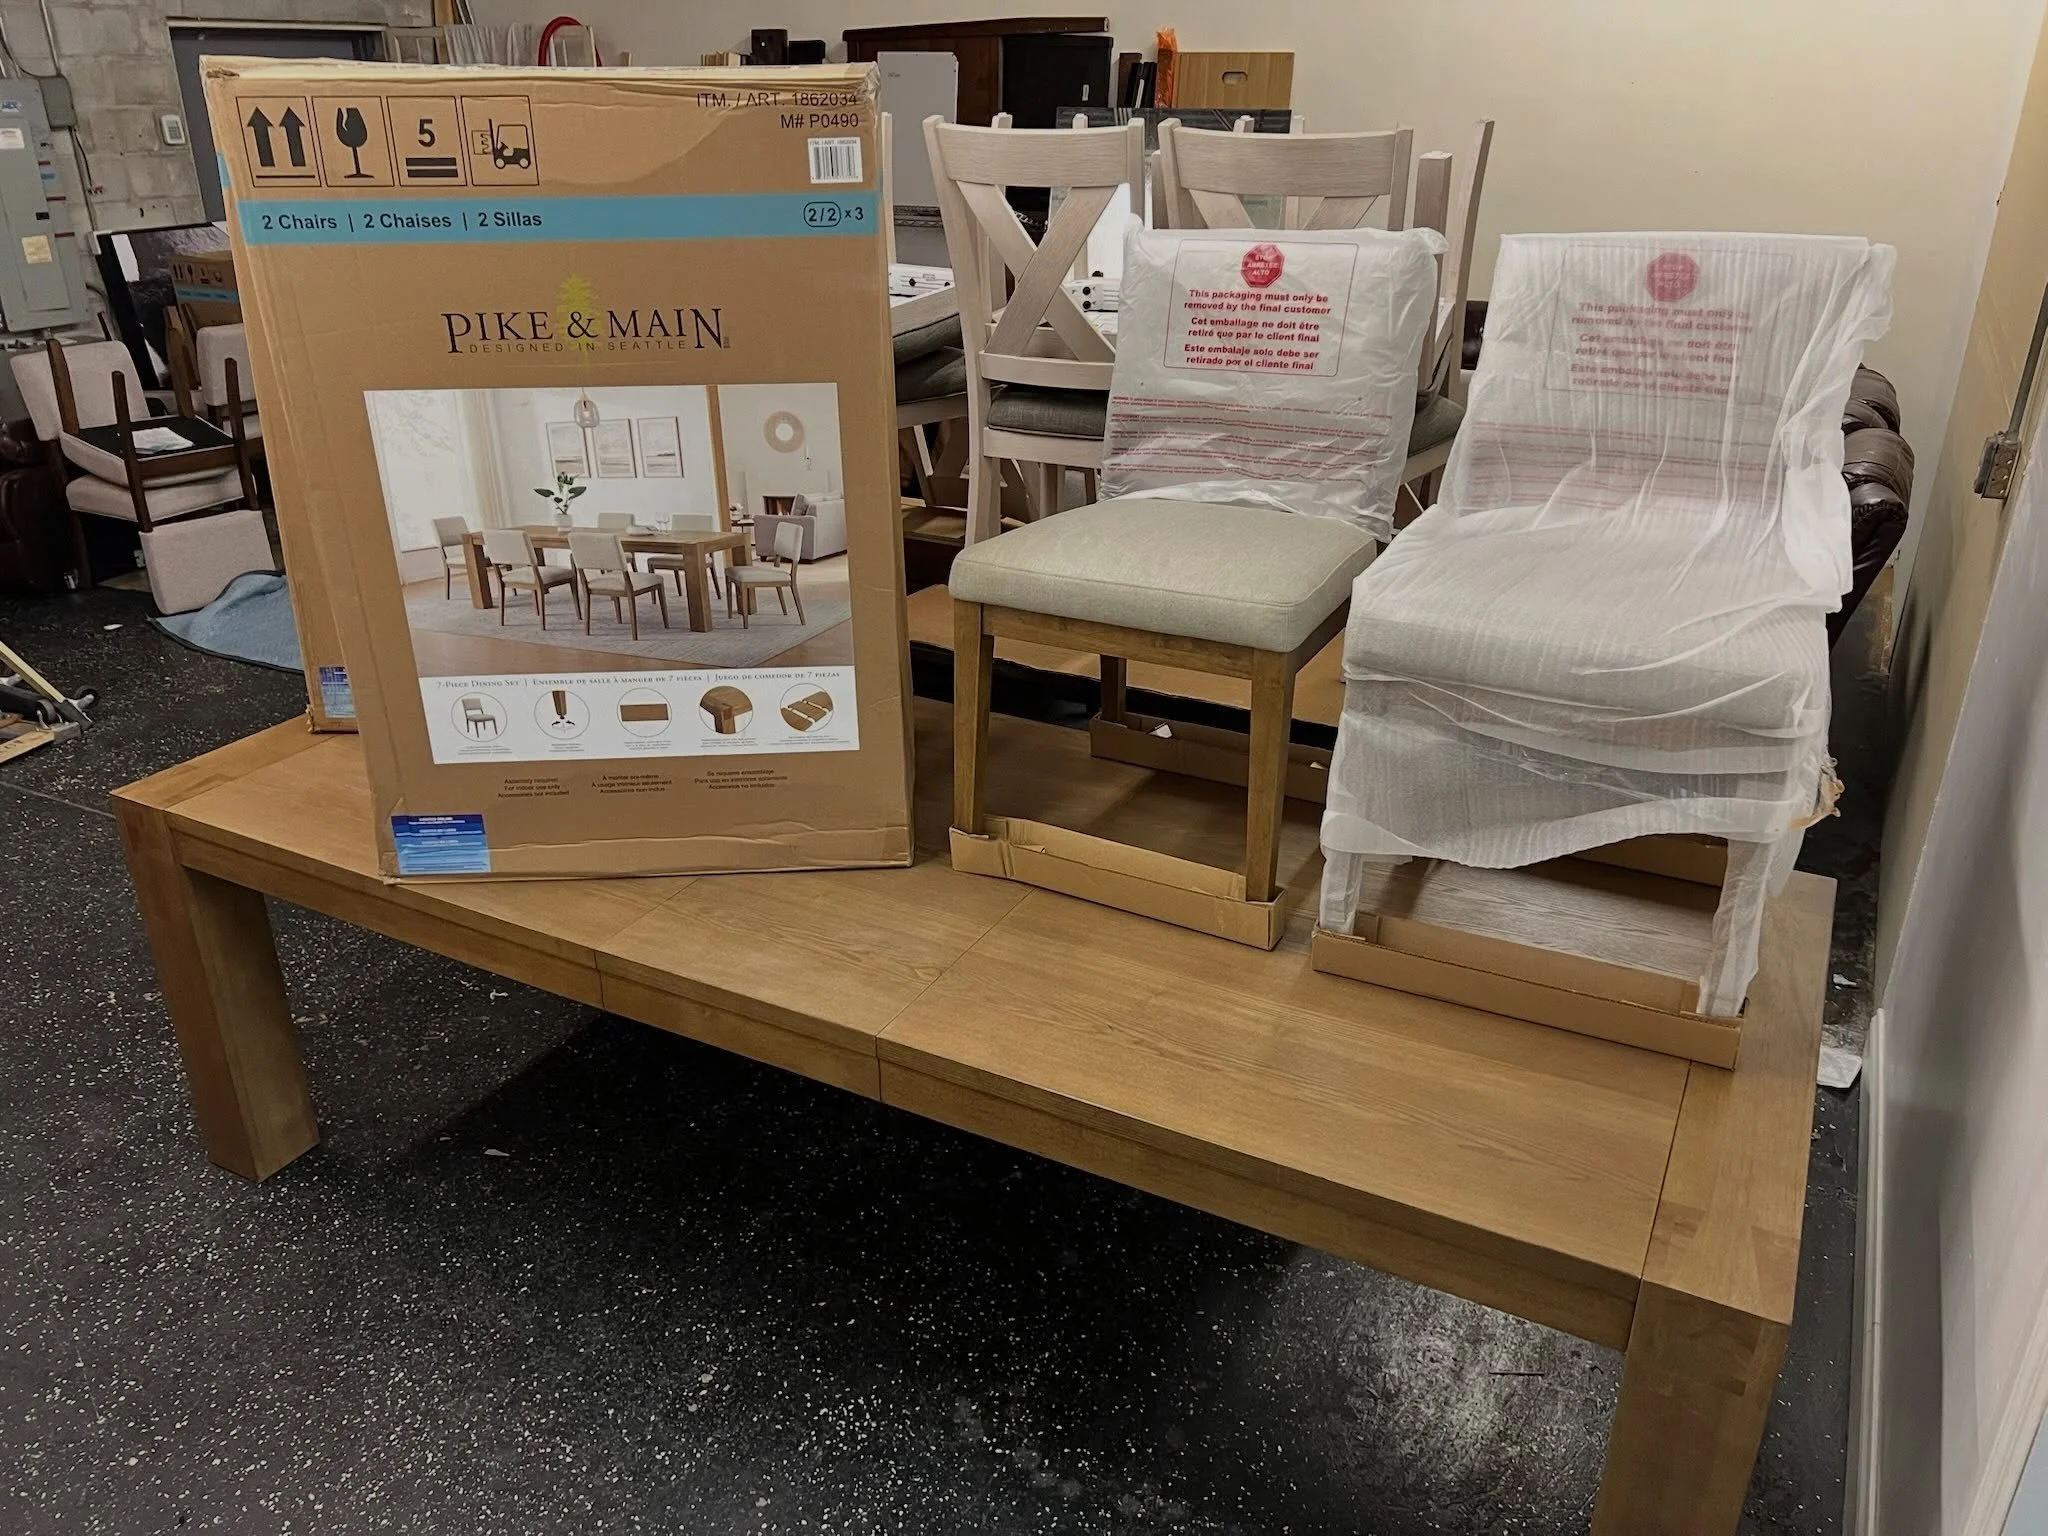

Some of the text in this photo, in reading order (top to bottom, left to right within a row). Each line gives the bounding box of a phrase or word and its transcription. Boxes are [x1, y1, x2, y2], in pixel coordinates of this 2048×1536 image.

[696, 93, 730, 107] ITM.
[747, 92, 785, 106] ART.
[793, 92, 858, 107] 1862034
[781, 113, 859, 128] M# P0490
[418, 118, 435, 147] 5
[262, 215, 273, 230] 2
[278, 214, 337, 230] Chairs
[364, 214, 376, 229] 2
[380, 213, 452, 229] Chaises
[478, 212, 489, 227] 2
[494, 211, 542, 227] Sillas
[1189, 289, 1328, 304] This packaging must only be
[1227, 302, 1238, 312] by
[1241, 303, 1256, 311] the
[1260, 304, 1281, 312] final
[1284, 306, 1331, 314] customer
[441, 308, 722, 353] PIKE & MAIN
[1191, 317, 1207, 325] Cet
[1210, 318, 1259, 328] emballage
[1277, 320, 1296, 329] doit
[1217, 331, 1233, 339] que
[1236, 332, 1252, 340] par
[1255, 331, 1263, 339] le
[1267, 332, 1294, 341] client
[1298, 333, 1319, 342] final
[470, 339, 686, 354] DESIGNED IN SEATTLE
[1184, 344, 1205, 352] Este
[1208, 346, 1250, 356] embalaje
[1253, 348, 1273, 356] solo
[1277, 349, 1300, 357] debe
[1186, 356, 1223, 365] retirado
[1226, 359, 1241, 367] por
[1256, 360, 1289, 368] cliente
[1292, 361, 1313, 370] final
